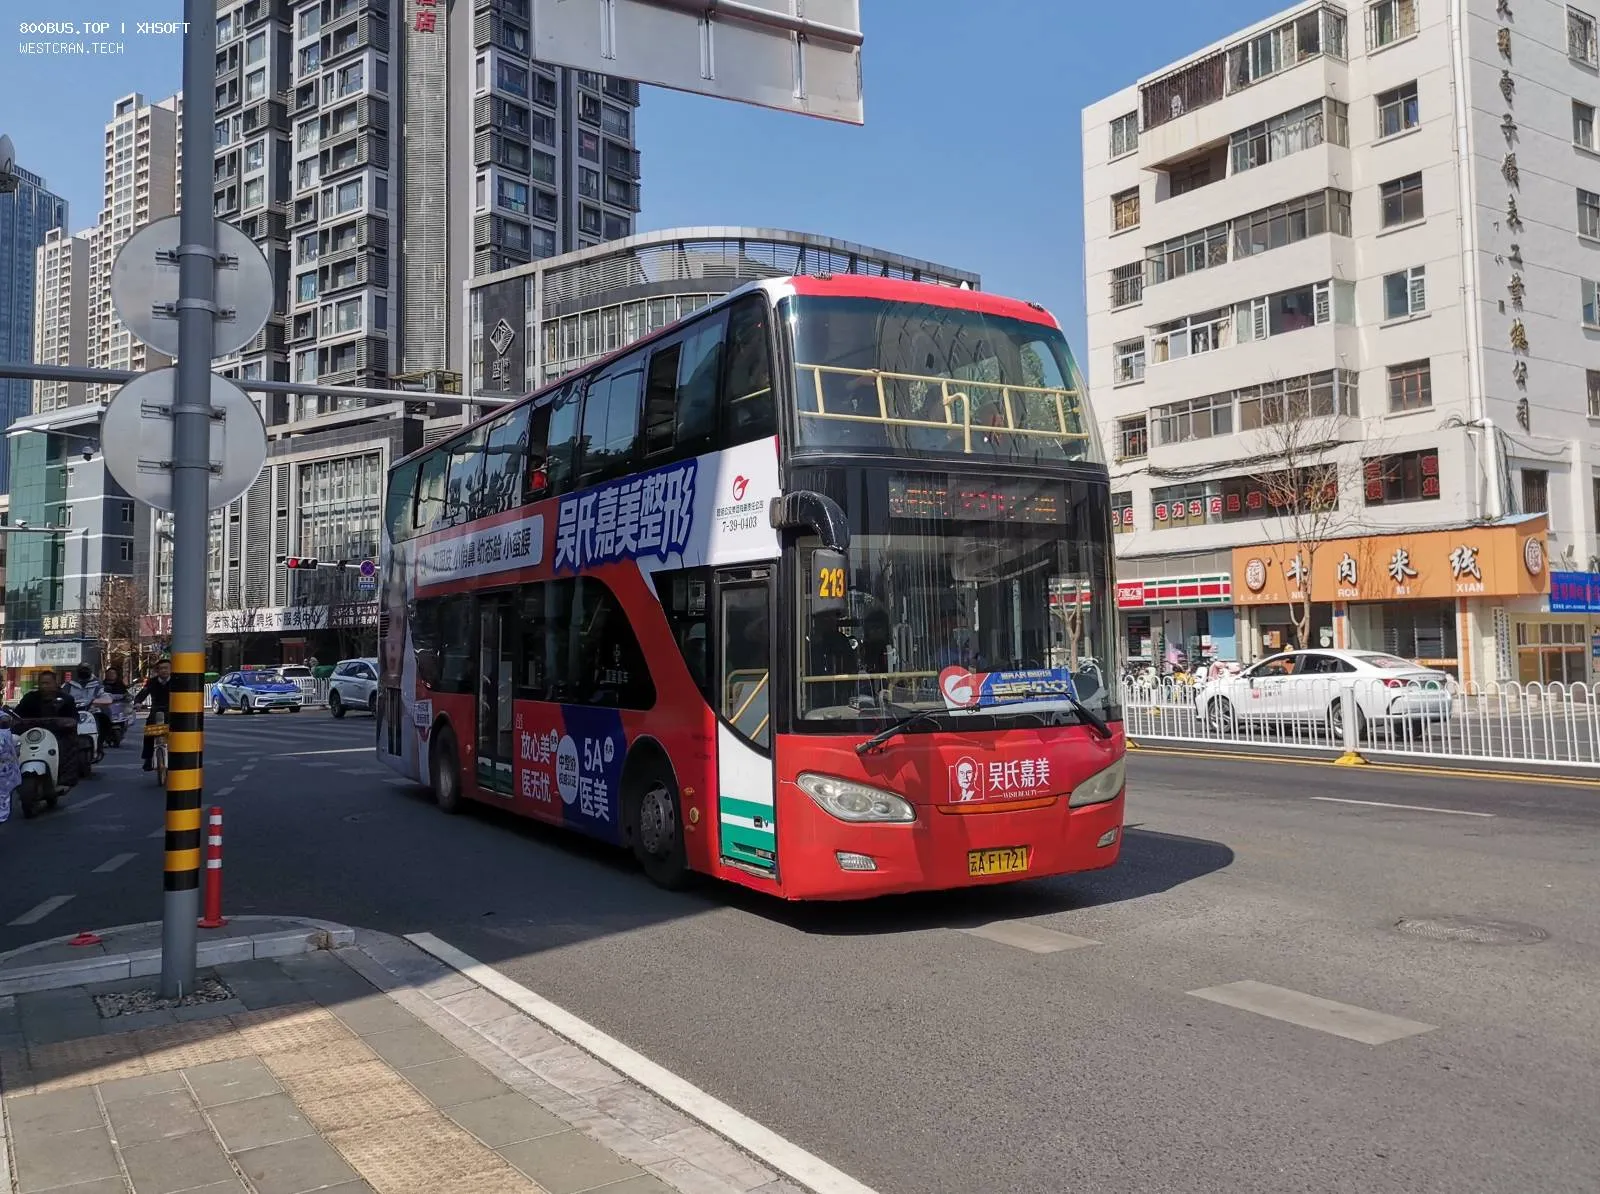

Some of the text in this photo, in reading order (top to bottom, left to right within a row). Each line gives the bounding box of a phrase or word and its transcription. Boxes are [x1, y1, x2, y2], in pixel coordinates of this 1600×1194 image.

[556, 466, 695, 569] 吴氏嘉美整形
[722, 516, 758, 532] 7-39-0403
[453, 541, 476, 569] 小俏鼻
[503, 527, 531, 560] 小蛮腰
[819, 567, 845, 598] 213
[1286, 544, 1482, 588] 牛肉米线
[1338, 588, 1358, 598] ROU
[1396, 585, 1410, 595] MI
[1457, 582, 1484, 593] XIAN
[521, 730, 551, 765] 放心美
[584, 737, 604, 773] 5A
[521, 768, 552, 803] 医无忧
[989, 757, 1051, 791] 吴氏嘉美
[580, 776, 611, 823] 医美
